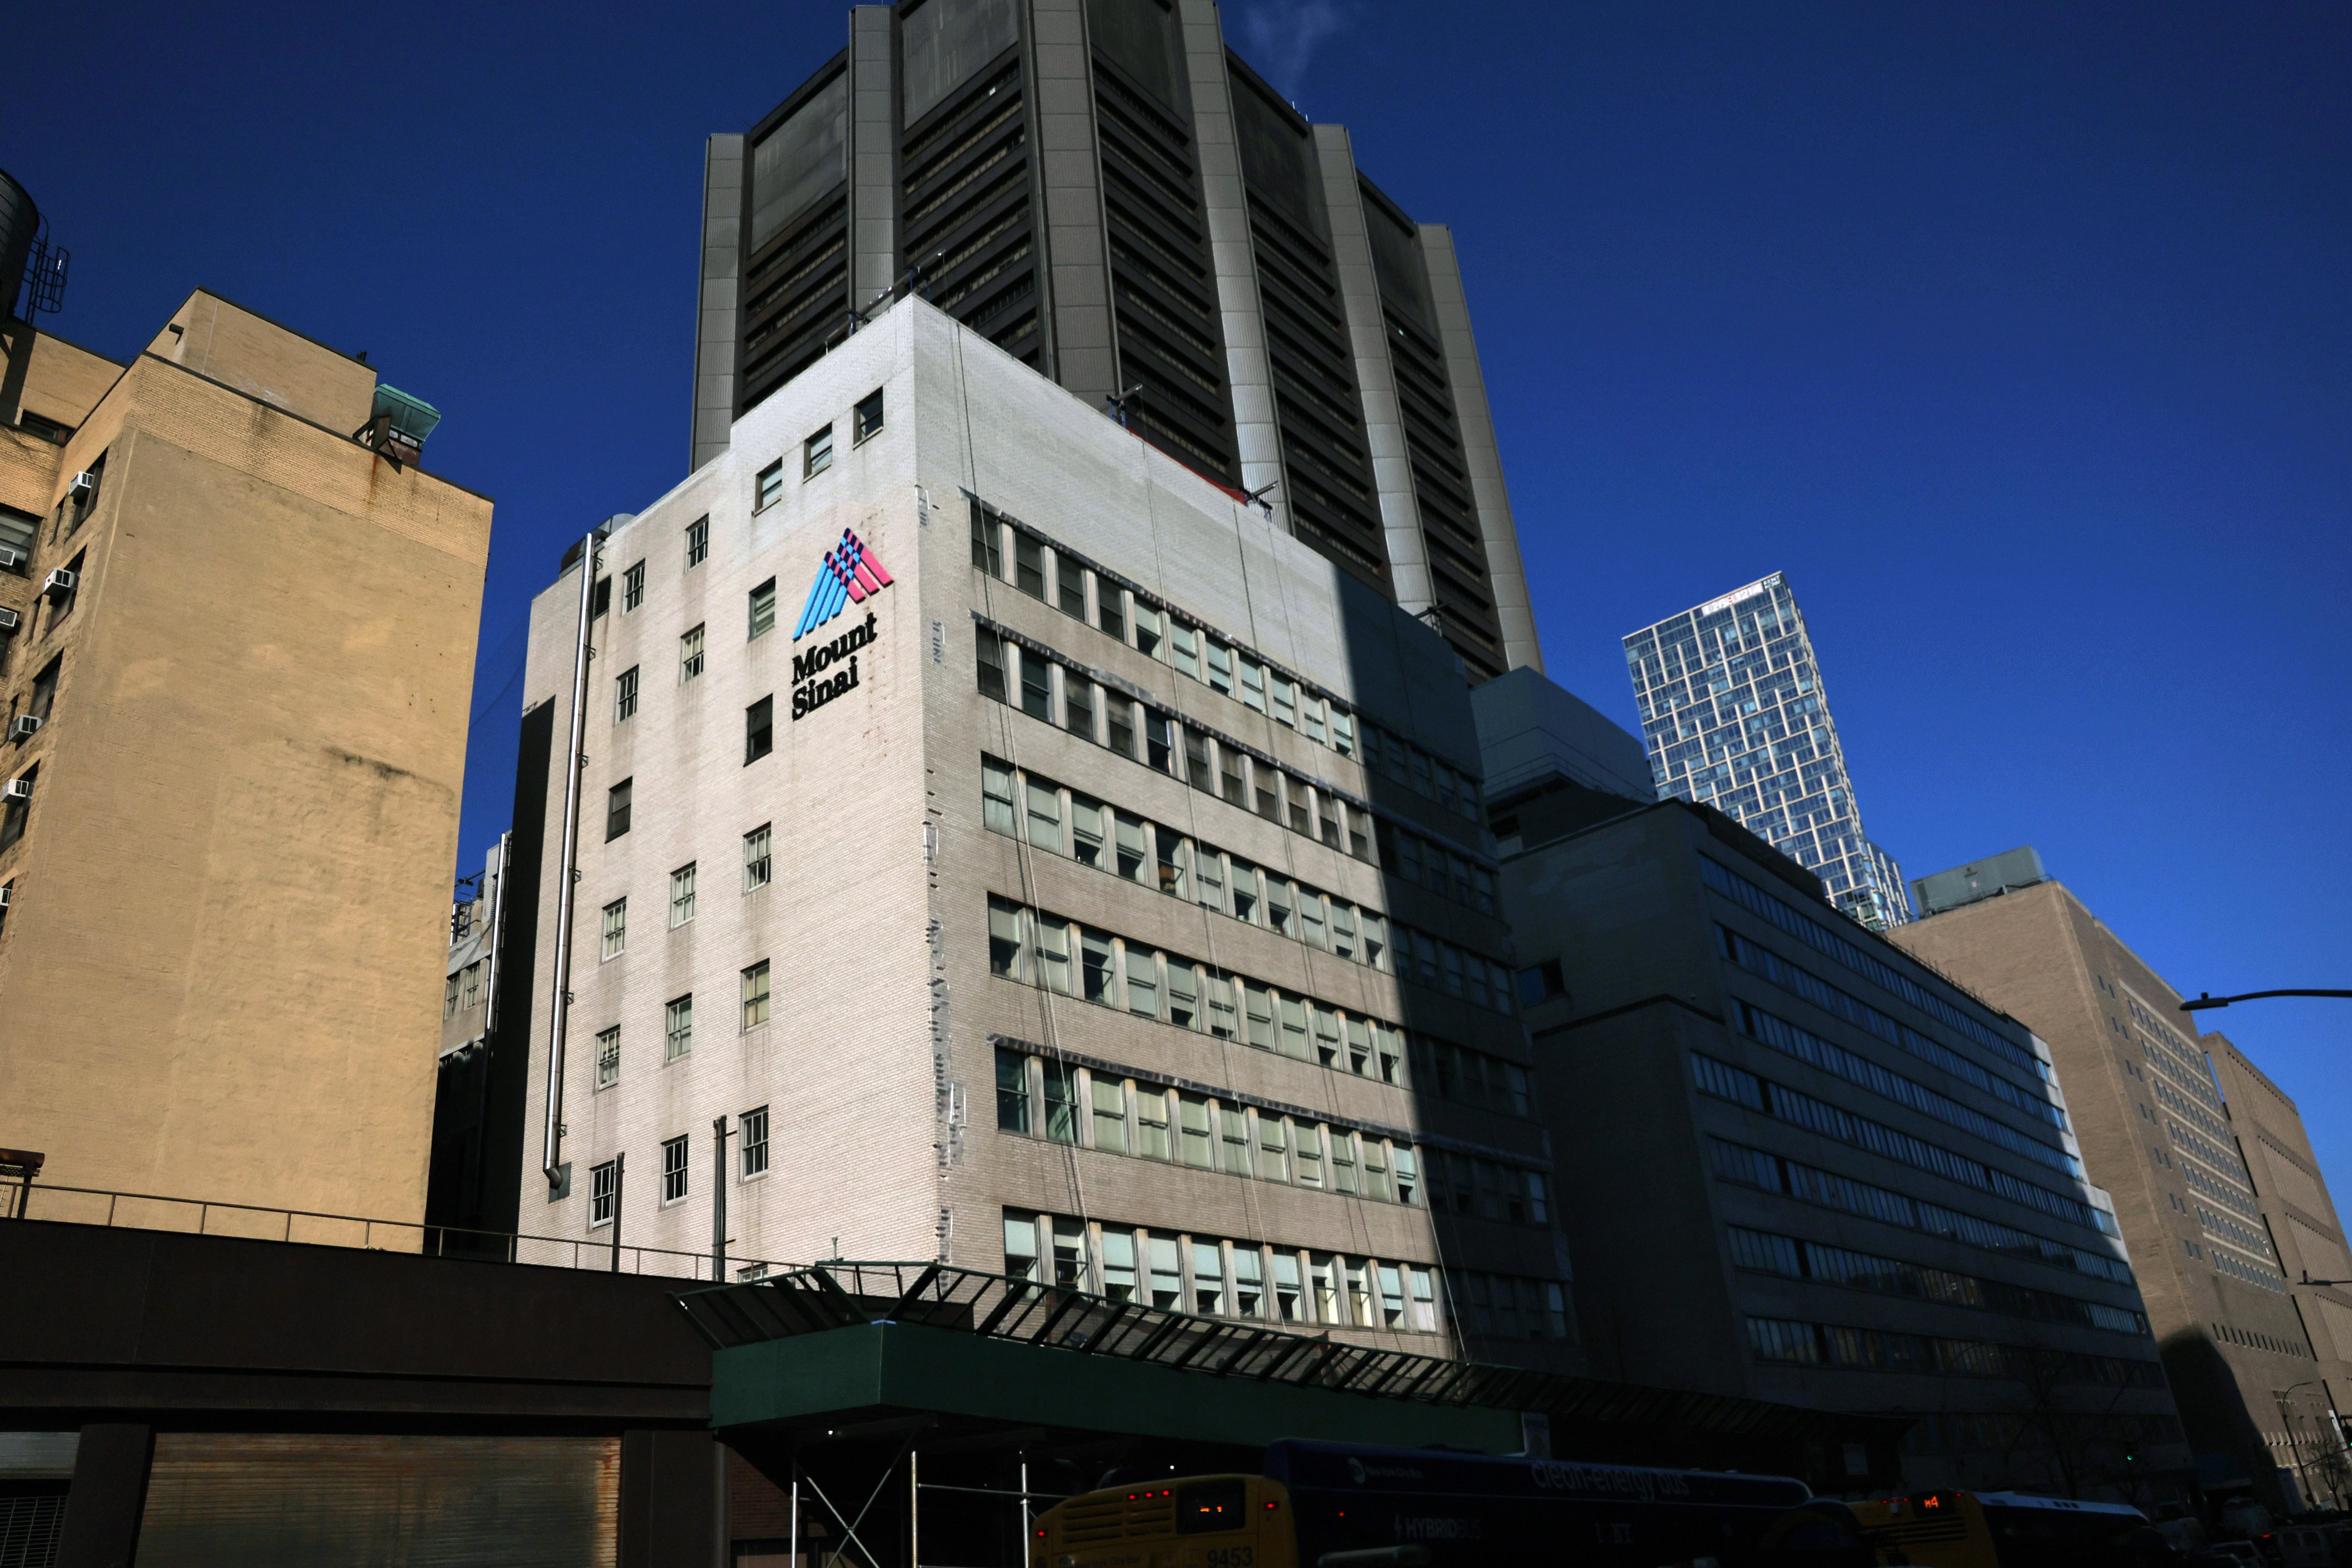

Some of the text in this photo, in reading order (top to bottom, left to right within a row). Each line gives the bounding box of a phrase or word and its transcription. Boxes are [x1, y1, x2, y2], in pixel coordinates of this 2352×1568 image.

[792, 612, 877, 686] Mount
[792, 656, 859, 721] Sinai
[1531, 1461, 1689, 1501] clean-energy bus
[1207, 1545, 1253, 1568] 9453
